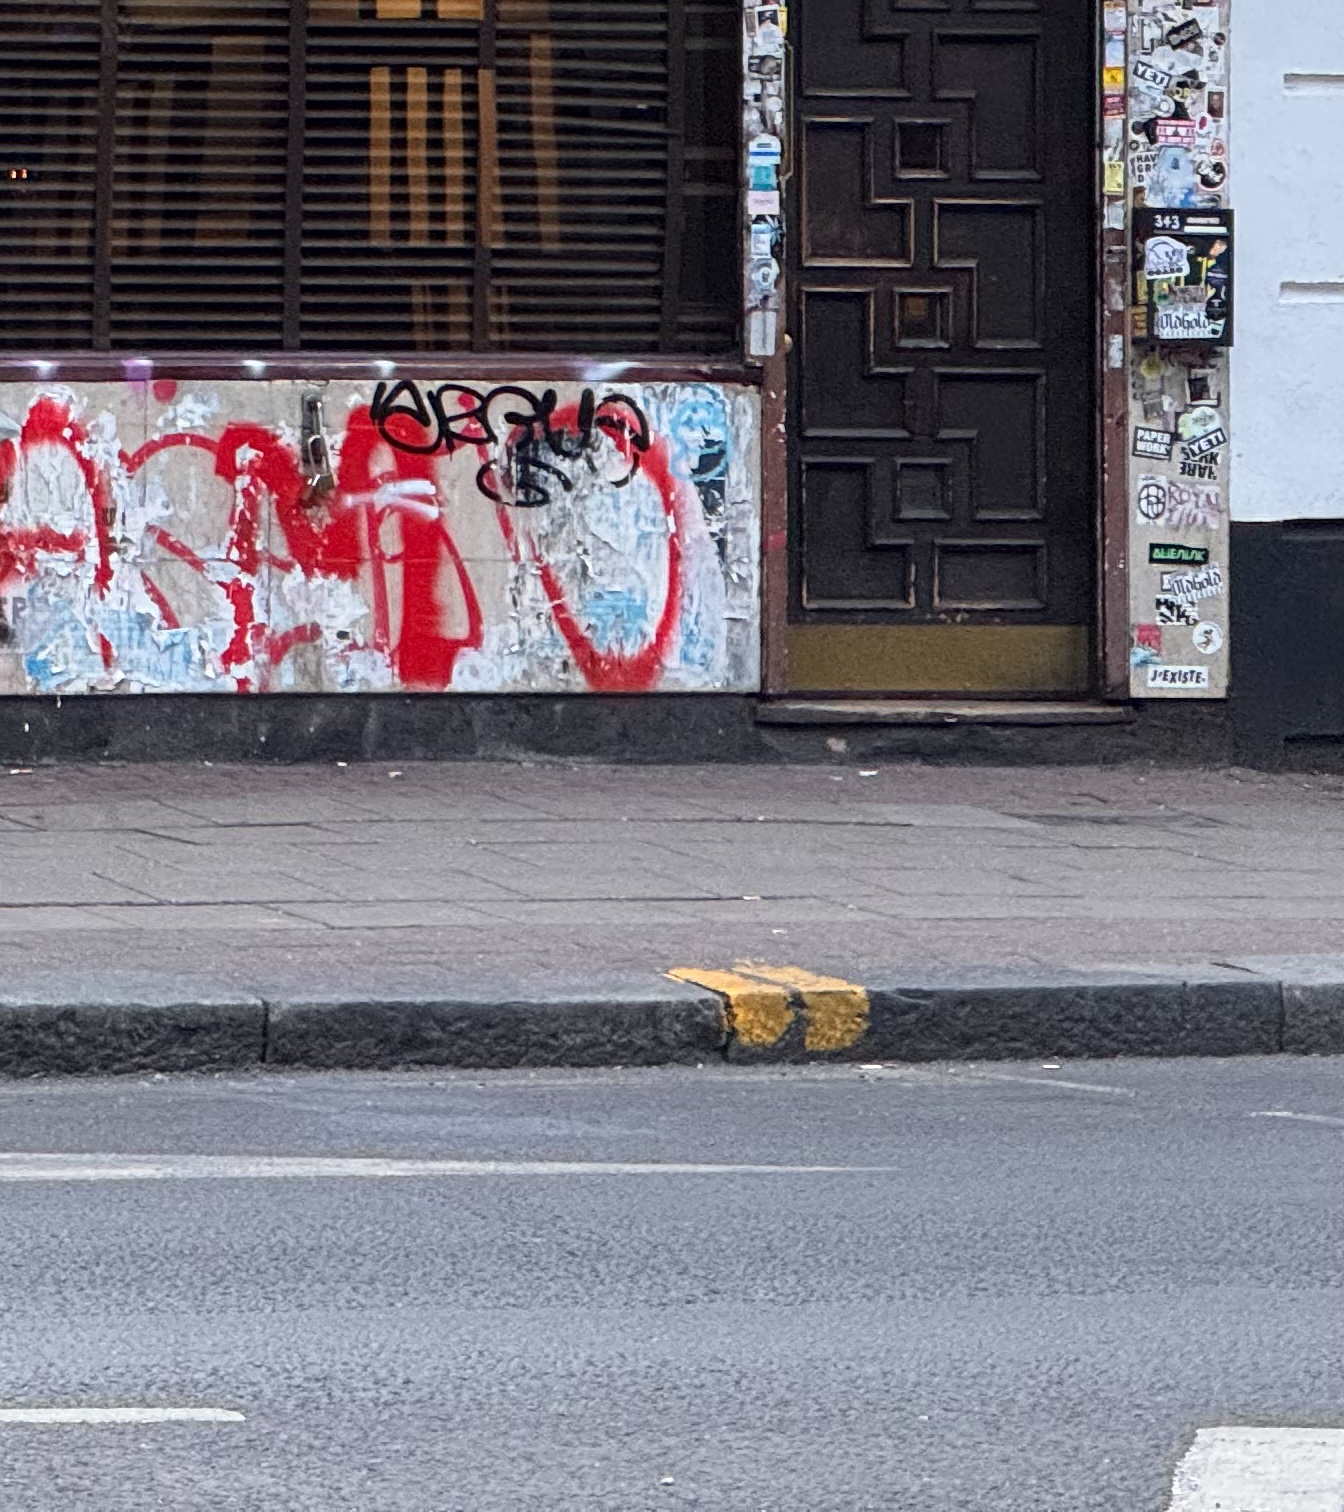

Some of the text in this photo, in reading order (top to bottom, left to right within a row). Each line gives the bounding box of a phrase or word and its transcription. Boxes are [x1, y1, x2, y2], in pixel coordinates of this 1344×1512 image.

[1135, 62, 1169, 87] YETI
[1153, 214, 1181, 229] 343
[1137, 429, 1171, 444] PAPER
[1189, 430, 1225, 454] YETI
